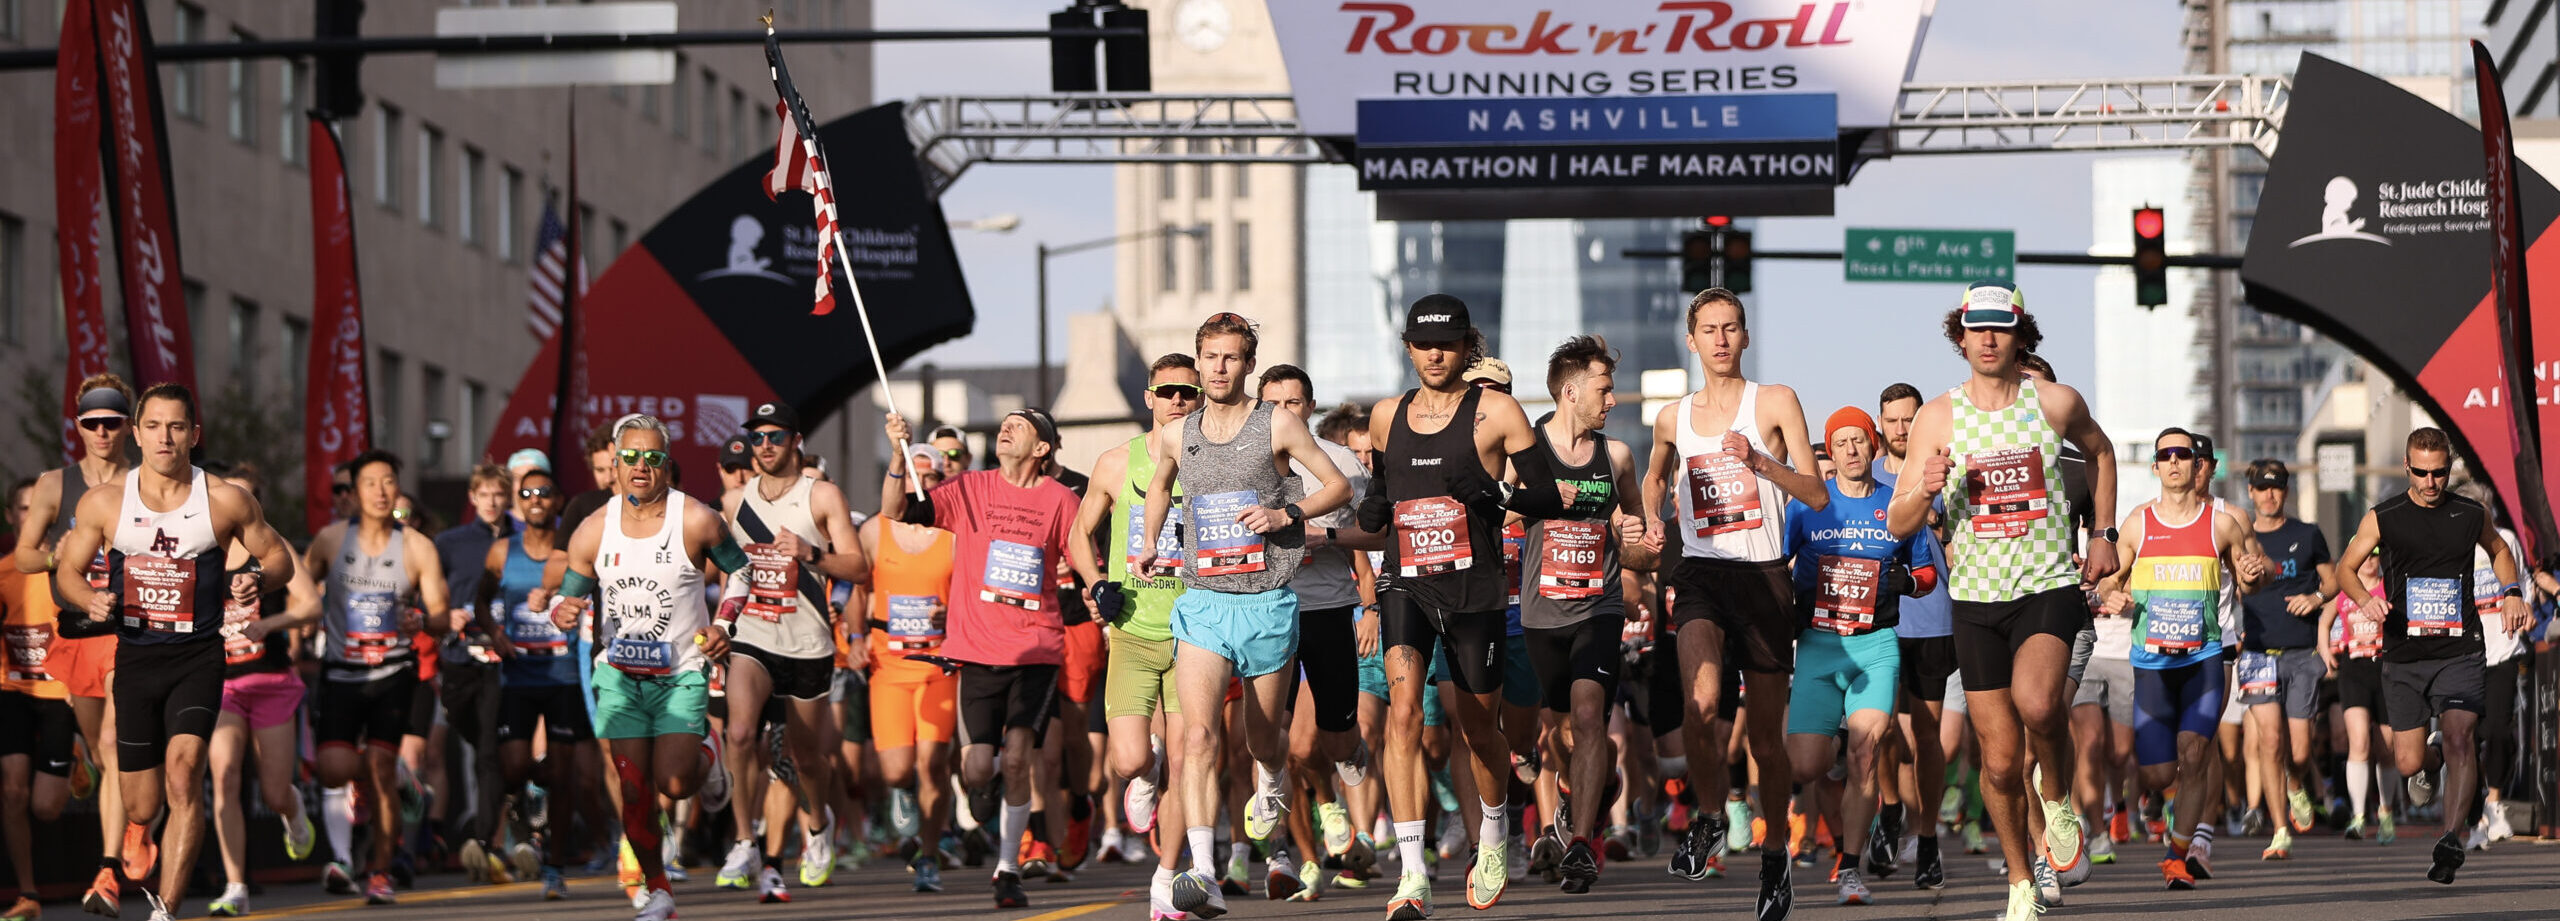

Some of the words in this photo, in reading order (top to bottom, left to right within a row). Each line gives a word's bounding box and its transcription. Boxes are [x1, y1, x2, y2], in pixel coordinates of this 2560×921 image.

[1338, 1, 1581, 55] Rock
[1657, 1, 1853, 54] Roll
[1393, 71, 1612, 95] RUNNING
[1628, 65, 1798, 94] SERIES
[1468, 105, 1739, 131] NASHVILLE
[1363, 155, 1538, 180] MARATHON
[1569, 153, 1648, 177] HALF
[1659, 153, 1834, 176] MARATHON
[2400, 180, 2436, 202] Jude
[2436, 178, 2487, 198] Childr
[2380, 197, 2447, 218] Research
[2449, 197, 2489, 218] Hosp
[2383, 222, 2416, 236] Finding
[2444, 220, 2474, 234] Saving
[1936, 240, 1971, 257] Ave
[1979, 237, 1995, 259] S
[1907, 260, 1953, 278] Parks
[1961, 265, 1990, 278] Blvd
[1417, 314, 1451, 324] BANDIT
[1417, 458, 1442, 466] BANDIT
[1981, 466, 2030, 487] 1023
[1700, 480, 1745, 501] 1030
[1994, 484, 2020, 493] ALEXIS
[1714, 497, 1733, 506] JACK
[984, 510, 1015, 524] Beverly
[1196, 506, 1220, 515] Rock
[1398, 512, 1427, 522] Rock
[1434, 508, 1460, 518] Roll
[1131, 533, 1183, 552] 202
[1408, 528, 1455, 548] 1020
[1548, 530, 1573, 540] Rock
[1581, 532, 1601, 540] Roll
[1428, 544, 1453, 553] GREER
[1551, 548, 1596, 564] 14169
[129, 566, 157, 576] Rock
[165, 569, 191, 579] Roll
[752, 568, 788, 585] 1024
[989, 566, 1039, 588] 23323
[1853, 569, 1874, 578] Roll
[2153, 563, 2203, 583] RYAN
[616, 576, 658, 592] BAYO
[1131, 577, 1176, 590] THURSDAY
[1823, 582, 1870, 600] 13437
[136, 586, 182, 605] 1022
[655, 588, 674, 609] ELI
[621, 604, 652, 619] ALMA
[2412, 602, 2457, 616] 20136
[2150, 620, 2199, 637] 20045
[2165, 633, 2182, 641] RYAN
[614, 644, 662, 660] 20114
